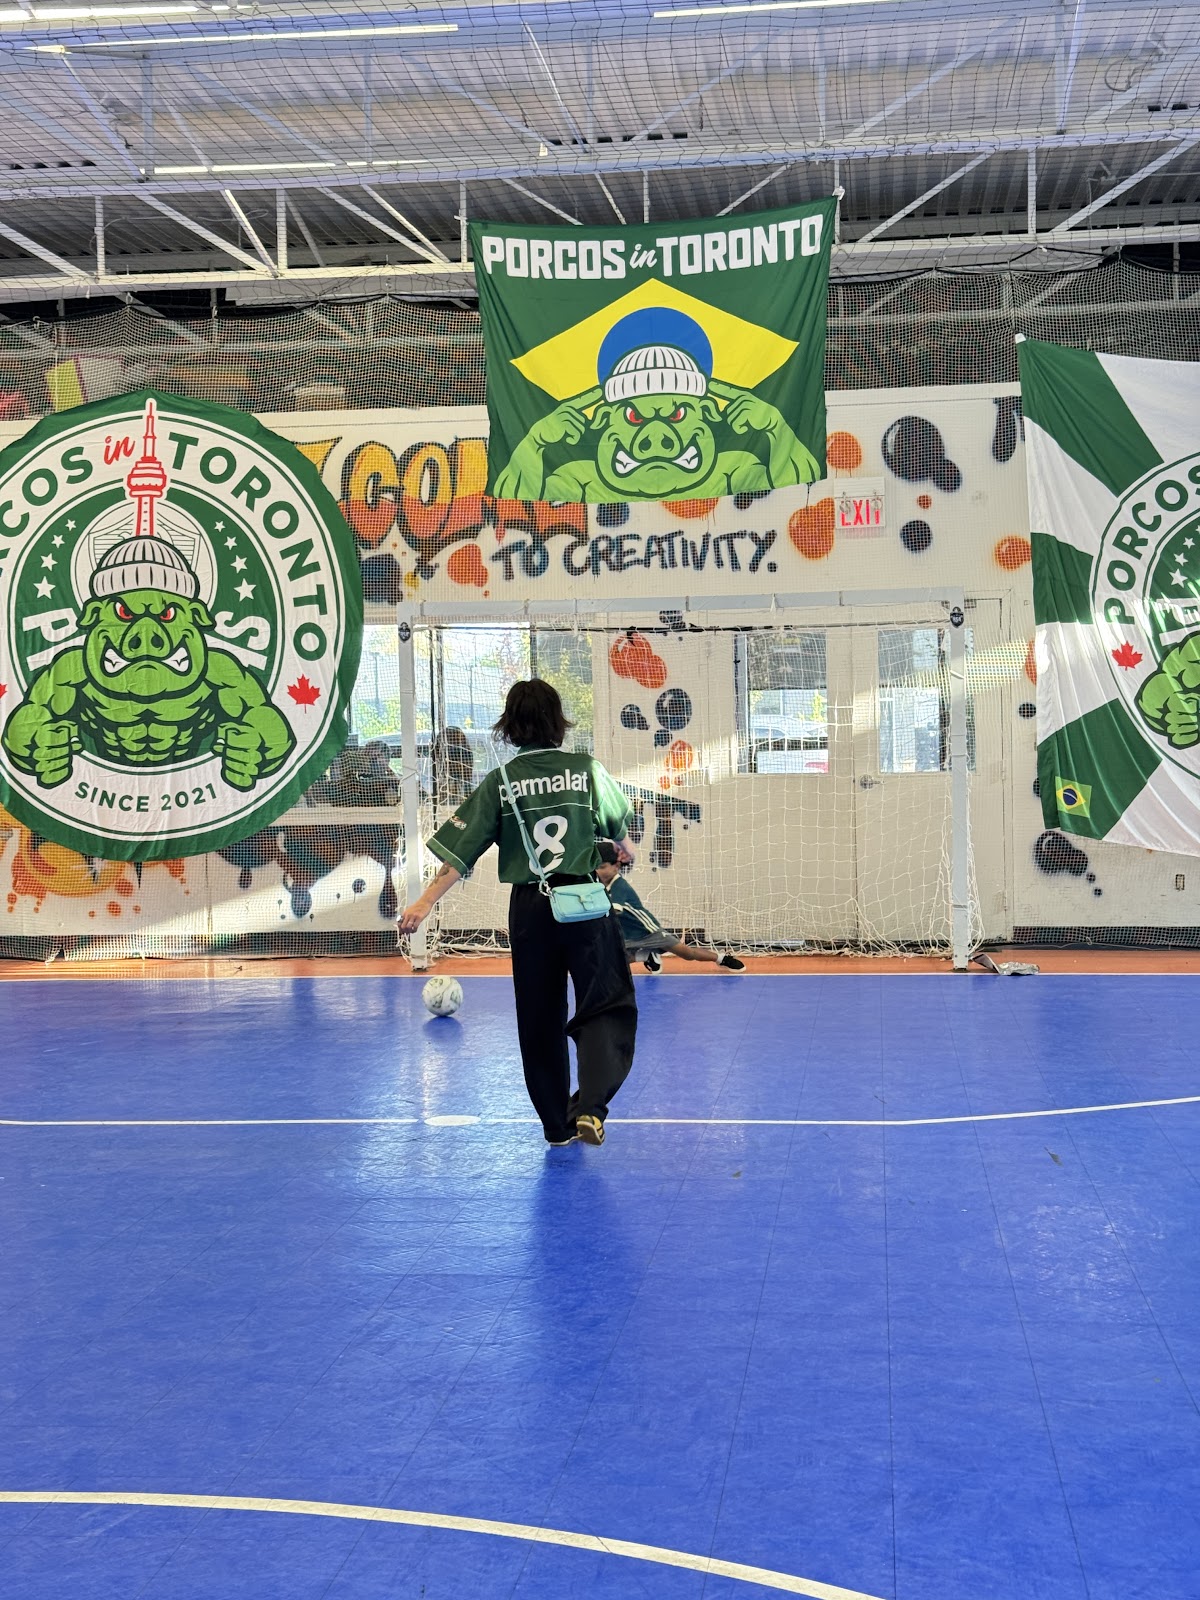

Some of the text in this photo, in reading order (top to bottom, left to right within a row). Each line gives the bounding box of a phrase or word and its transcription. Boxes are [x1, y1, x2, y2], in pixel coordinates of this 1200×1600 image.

[481, 213, 824, 280] PORCOS in TORONTO
[103, 435, 136, 465] in
[168, 431, 328, 662] TORONTO
[489, 529, 779, 581] TO CREATIVITY.
[74, 781, 217, 813] SINCE 2021
[498, 768, 589, 807] parmalat
[529, 814, 569, 876] 8
